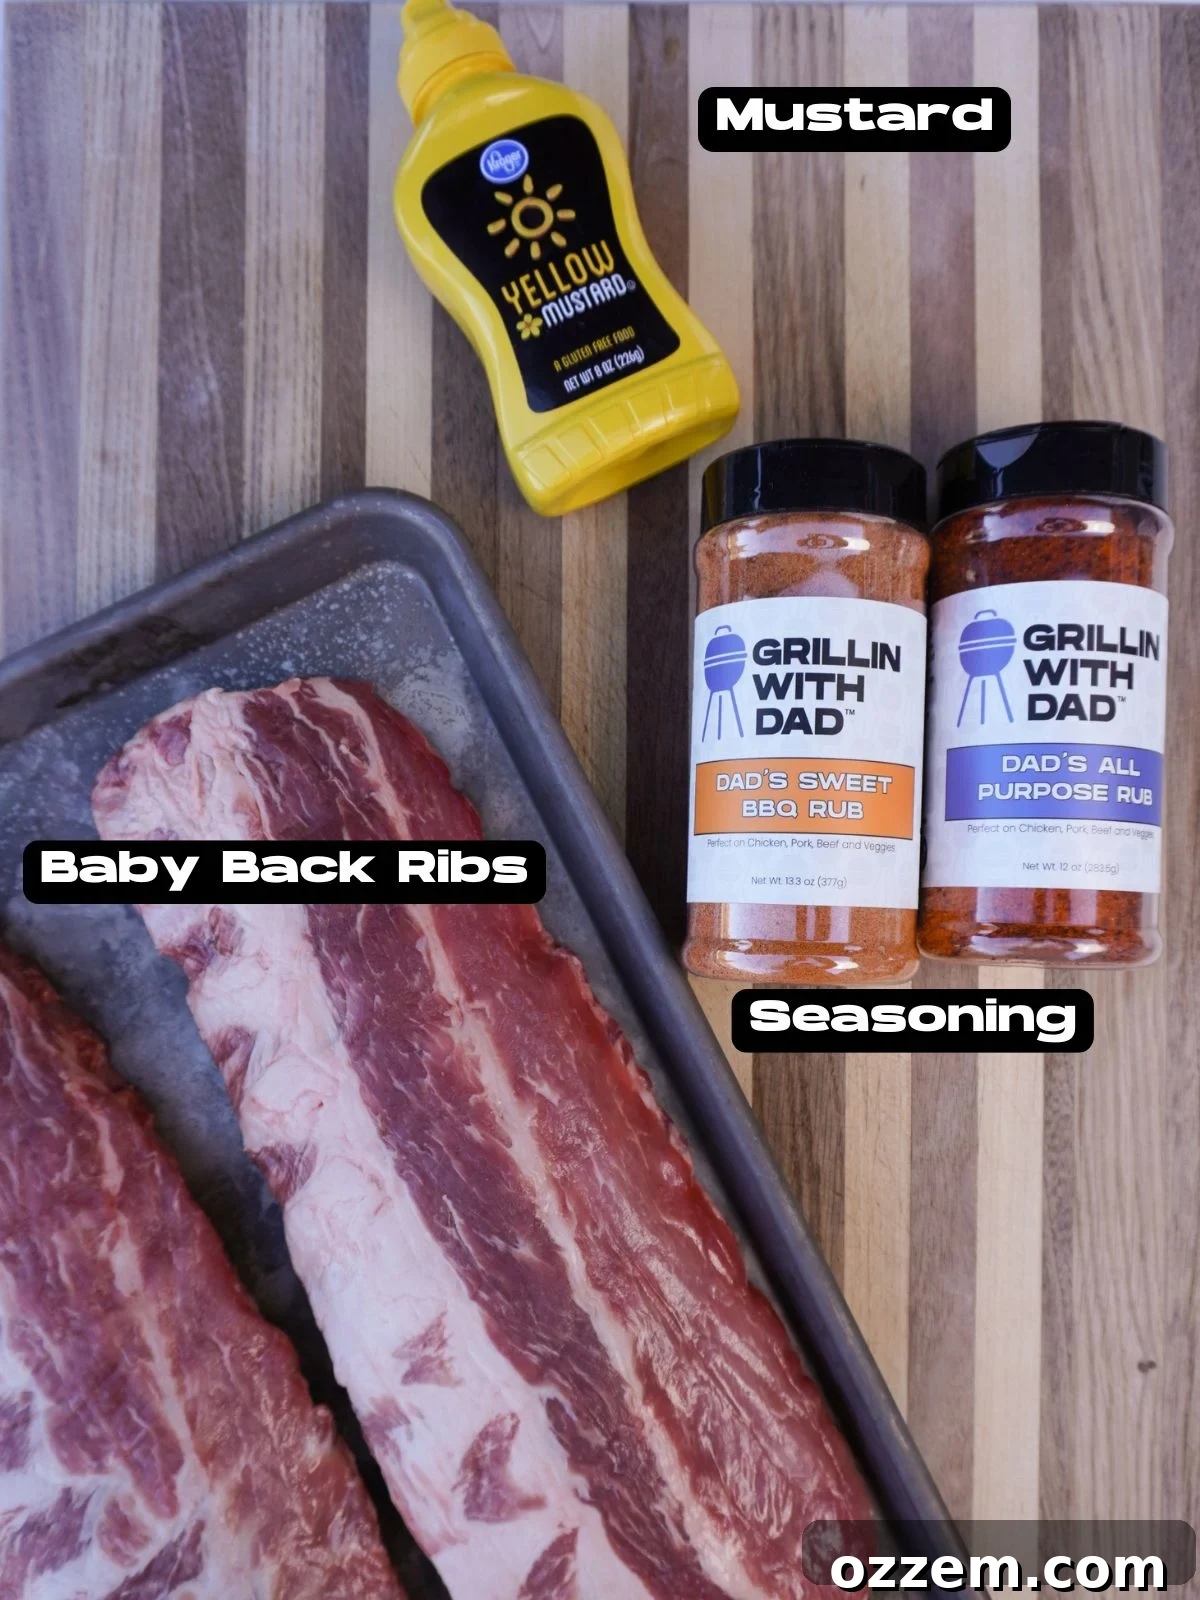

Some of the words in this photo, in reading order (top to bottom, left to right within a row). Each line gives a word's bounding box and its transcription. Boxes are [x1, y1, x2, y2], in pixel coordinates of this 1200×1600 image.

[501, 239, 614, 314] YELLOW
[541, 273, 627, 327] MUSTARD
[553, 359, 562, 372] A
[561, 344, 593, 368] GLUTEN
[592, 335, 613, 353] FREE
[612, 325, 636, 344] FOOD
[563, 375, 580, 393] NET
[579, 367, 595, 386] WT
[593, 364, 603, 378] 8
[601, 358, 616, 375] OZ
[613, 344, 645, 370] (226g)
[752, 637, 901, 673] GRILLIN
[1023, 623, 1160, 661] GRILLIN
[752, 672, 864, 702] WITH
[1023, 658, 1134, 690] WITH
[1002, 752, 1087, 774] DAD'S
[1099, 755, 1141, 777] ALL
[716, 769, 788, 793] DAD'S
[798, 771, 892, 795] SWEET
[978, 783, 1109, 802] PURPOSE
[1117, 785, 1153, 806] RUB
[742, 799, 799, 820] BBQ
[808, 800, 864, 819] RUB
[967, 824, 1000, 834] Perfect
[1002, 825, 1017, 833] on
[1018, 823, 1063, 834] Chicken,
[1091, 824, 1113, 835] Beef
[1114, 826, 1131, 837] and
[707, 838, 732, 848] Perfect
[734, 840, 746, 848] on
[747, 838, 788, 849] Chicken,
[791, 838, 814, 849] Pork,
[816, 838, 839, 848] Beef
[842, 839, 862, 850] and
[864, 841, 896, 854] Veggies
[1022, 862, 1040, 871] Net
[1059, 862, 1069, 872] 12
[1071, 864, 1082, 872] oz
[751, 876, 766, 886] Net
[785, 876, 801, 886] 13.3
[804, 878, 815, 886] oz
[817, 875, 848, 890] (377g)
